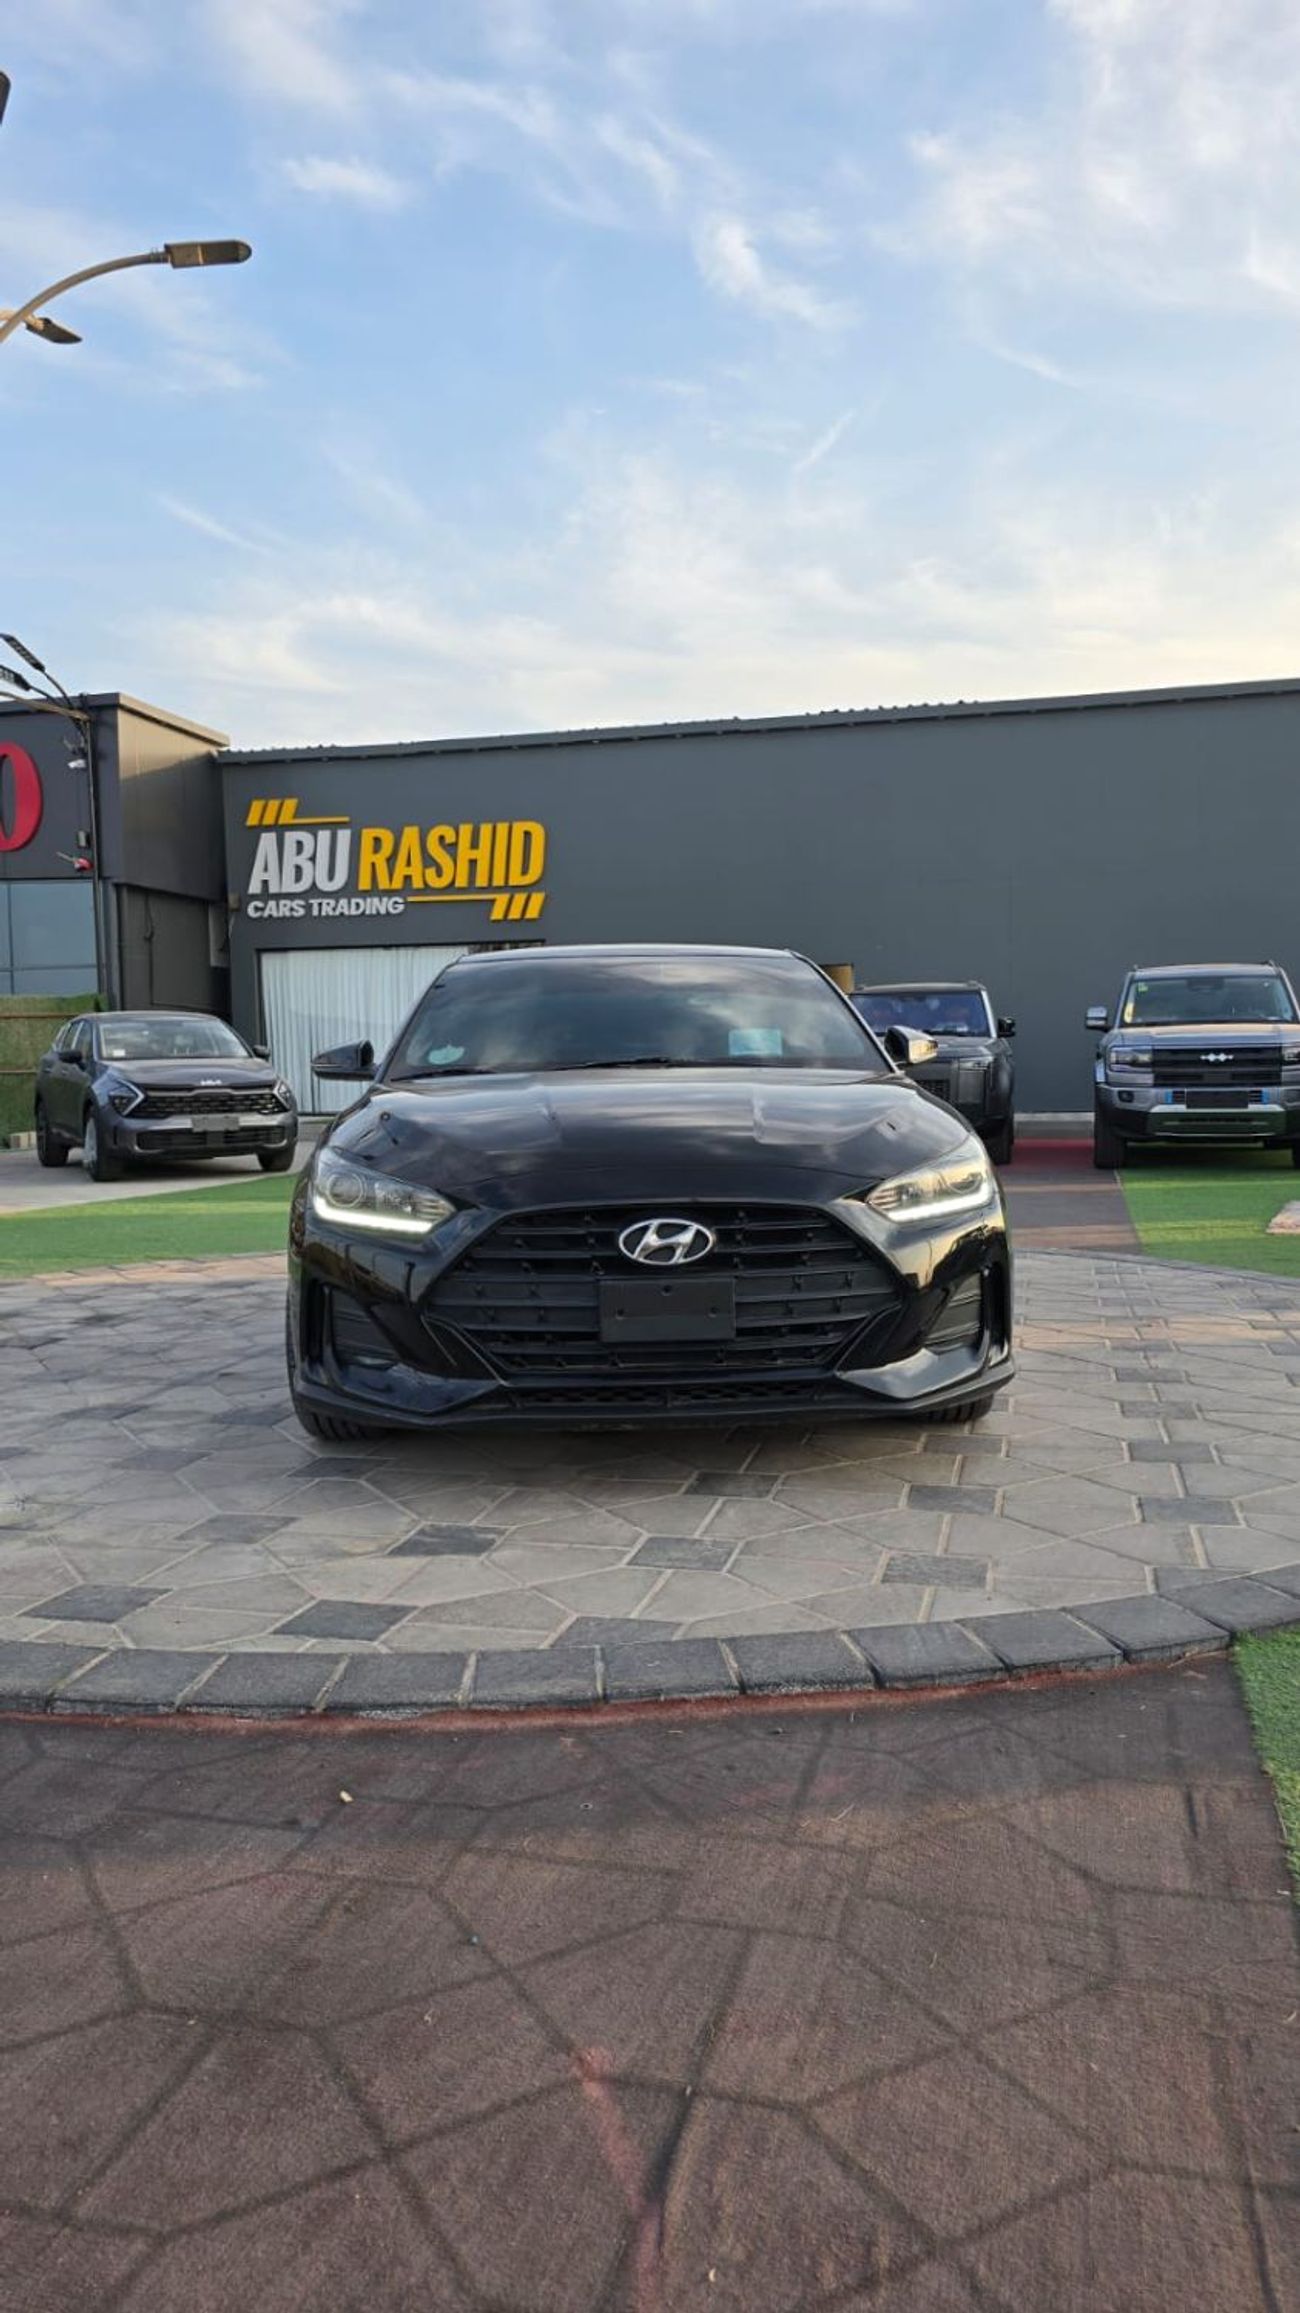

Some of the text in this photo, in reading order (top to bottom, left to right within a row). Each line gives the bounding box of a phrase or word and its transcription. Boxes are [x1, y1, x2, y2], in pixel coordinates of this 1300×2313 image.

[248, 821, 546, 894] ABU RASHID
[247, 896, 405, 918] CARS TRADING
